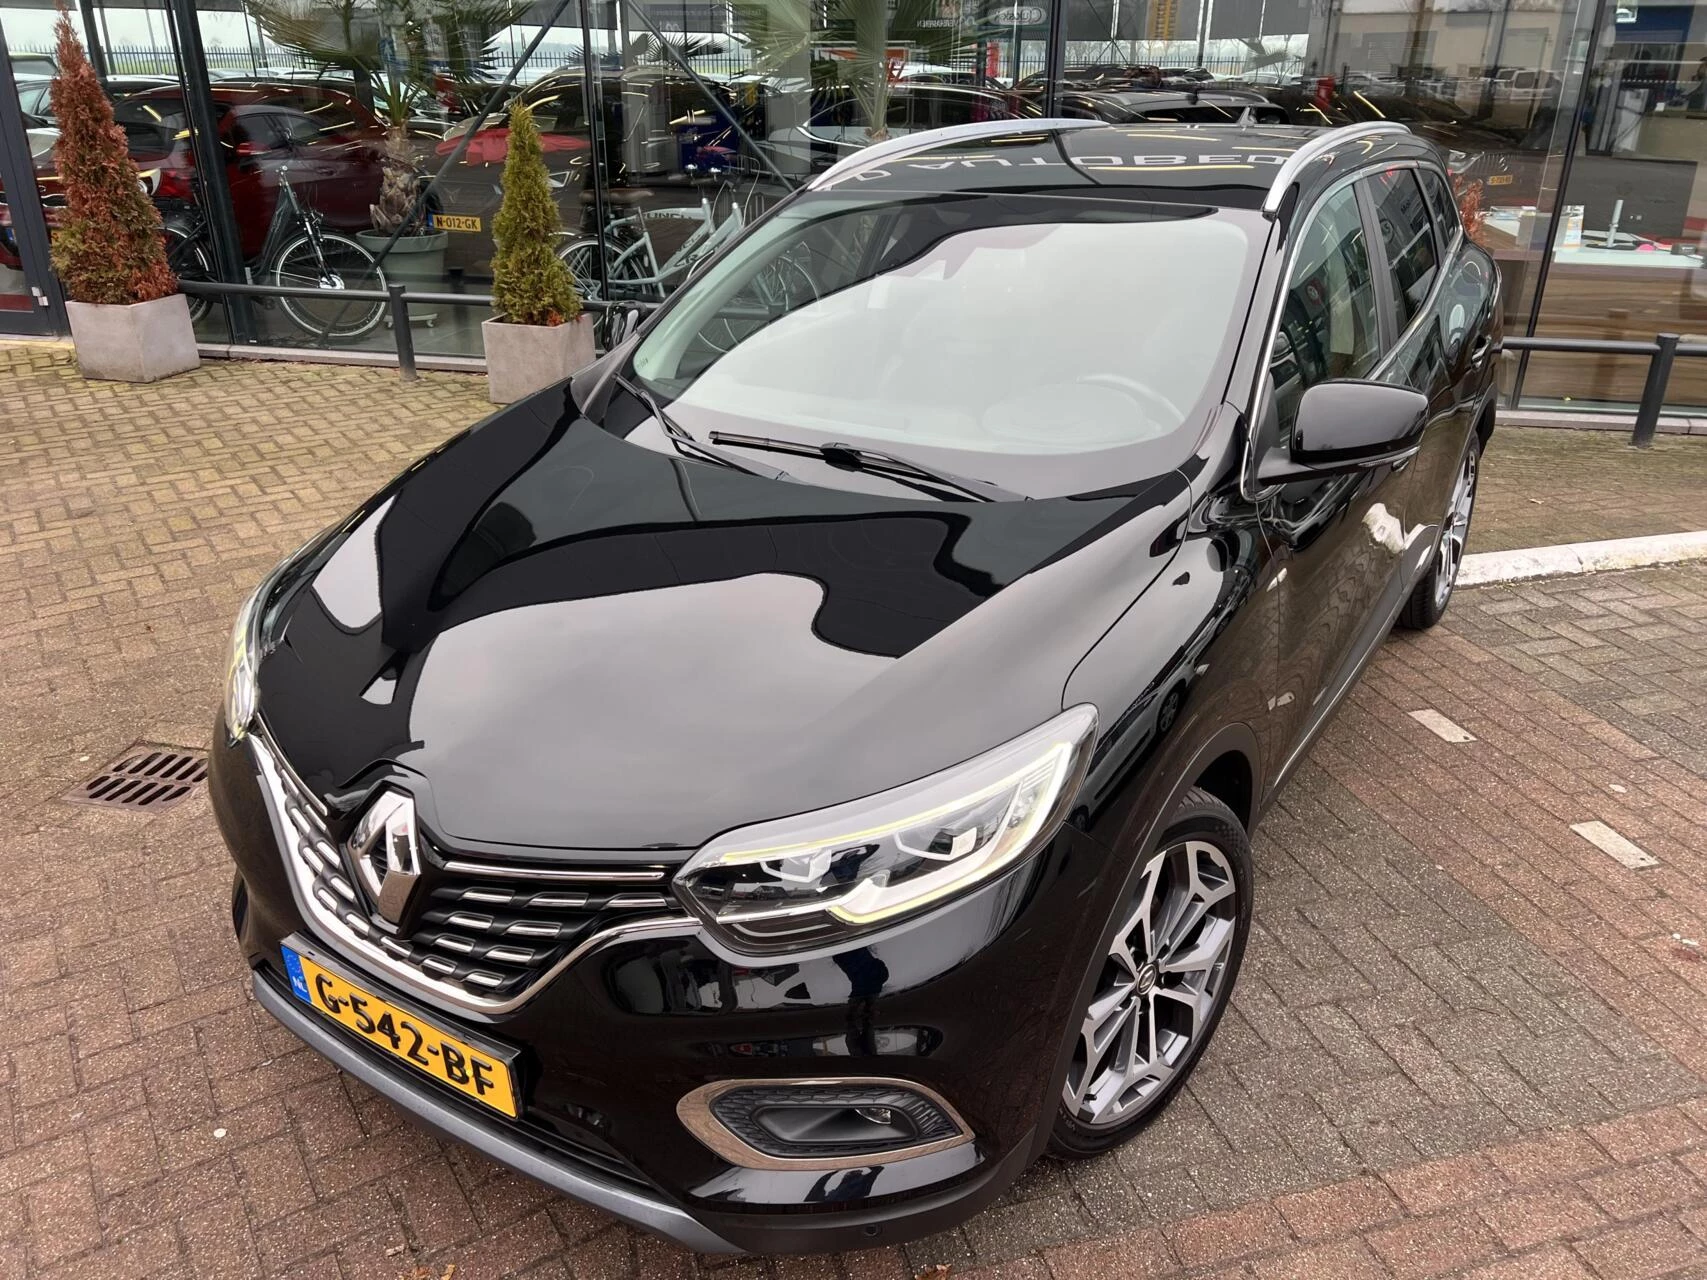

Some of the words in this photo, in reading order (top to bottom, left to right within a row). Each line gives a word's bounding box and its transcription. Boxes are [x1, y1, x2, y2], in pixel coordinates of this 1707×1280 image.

[436, 216, 478, 229] N-012-GK
[292, 976, 308, 993] NL
[315, 973, 494, 1096] G-542-BF
